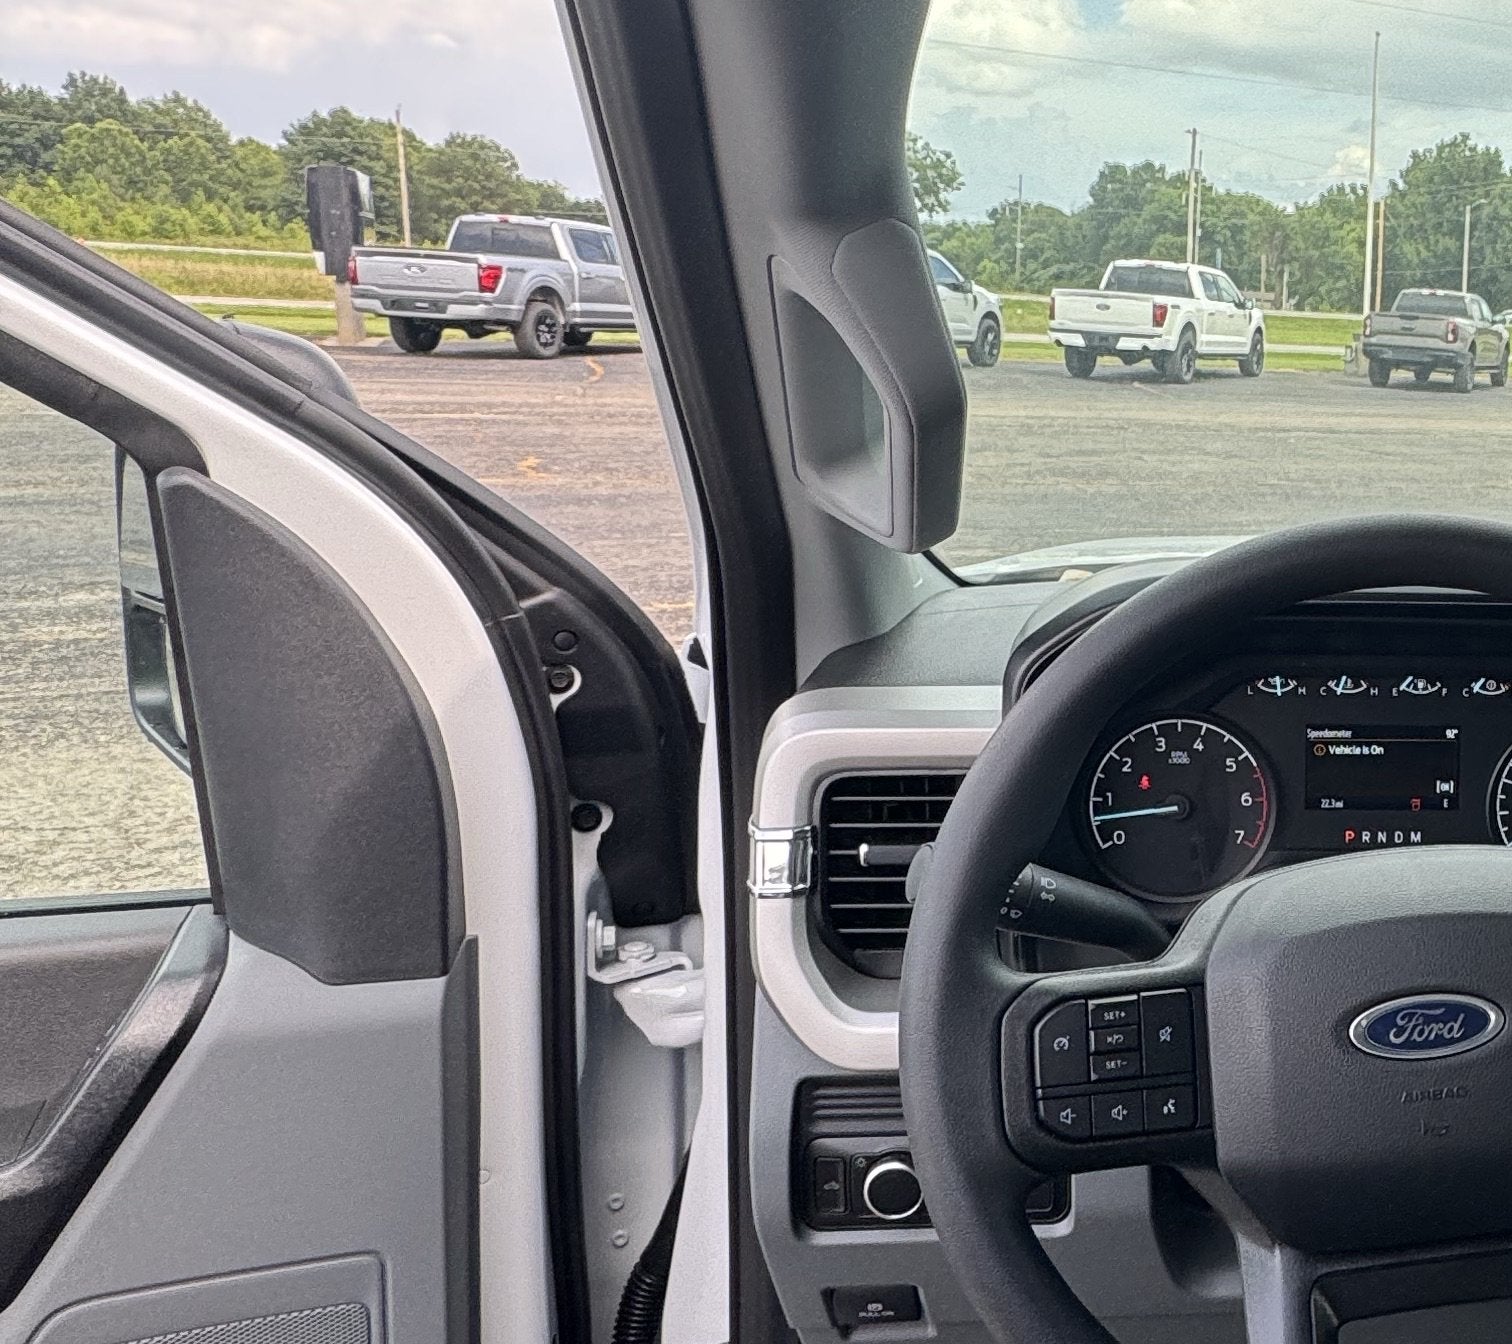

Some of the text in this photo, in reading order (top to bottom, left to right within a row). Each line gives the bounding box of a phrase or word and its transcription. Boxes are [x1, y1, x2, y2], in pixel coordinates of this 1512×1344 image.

[1247, 685, 1254, 695] L
[1298, 686, 1306, 695] H
[1320, 686, 1327, 696] C
[1370, 686, 1378, 696] H
[1392, 688, 1398, 696] E
[1442, 688, 1448, 697] F
[1462, 688, 1470, 697] C
[1155, 737, 1165, 751] 3
[1193, 738, 1204, 751] 4
[1328, 745, 1384, 755] Vehicle is On
[1122, 758, 1132, 772] 2
[1226, 758, 1236, 772] 5
[1106, 792, 1112, 806] 1
[1241, 792, 1252, 806] 6
[1444, 799, 1448, 808] E
[1113, 831, 1125, 844] 0
[1235, 830, 1245, 844] 7
[1345, 831, 1421, 843] P R N D M
[1389, 1008, 1465, 1044] Ford
